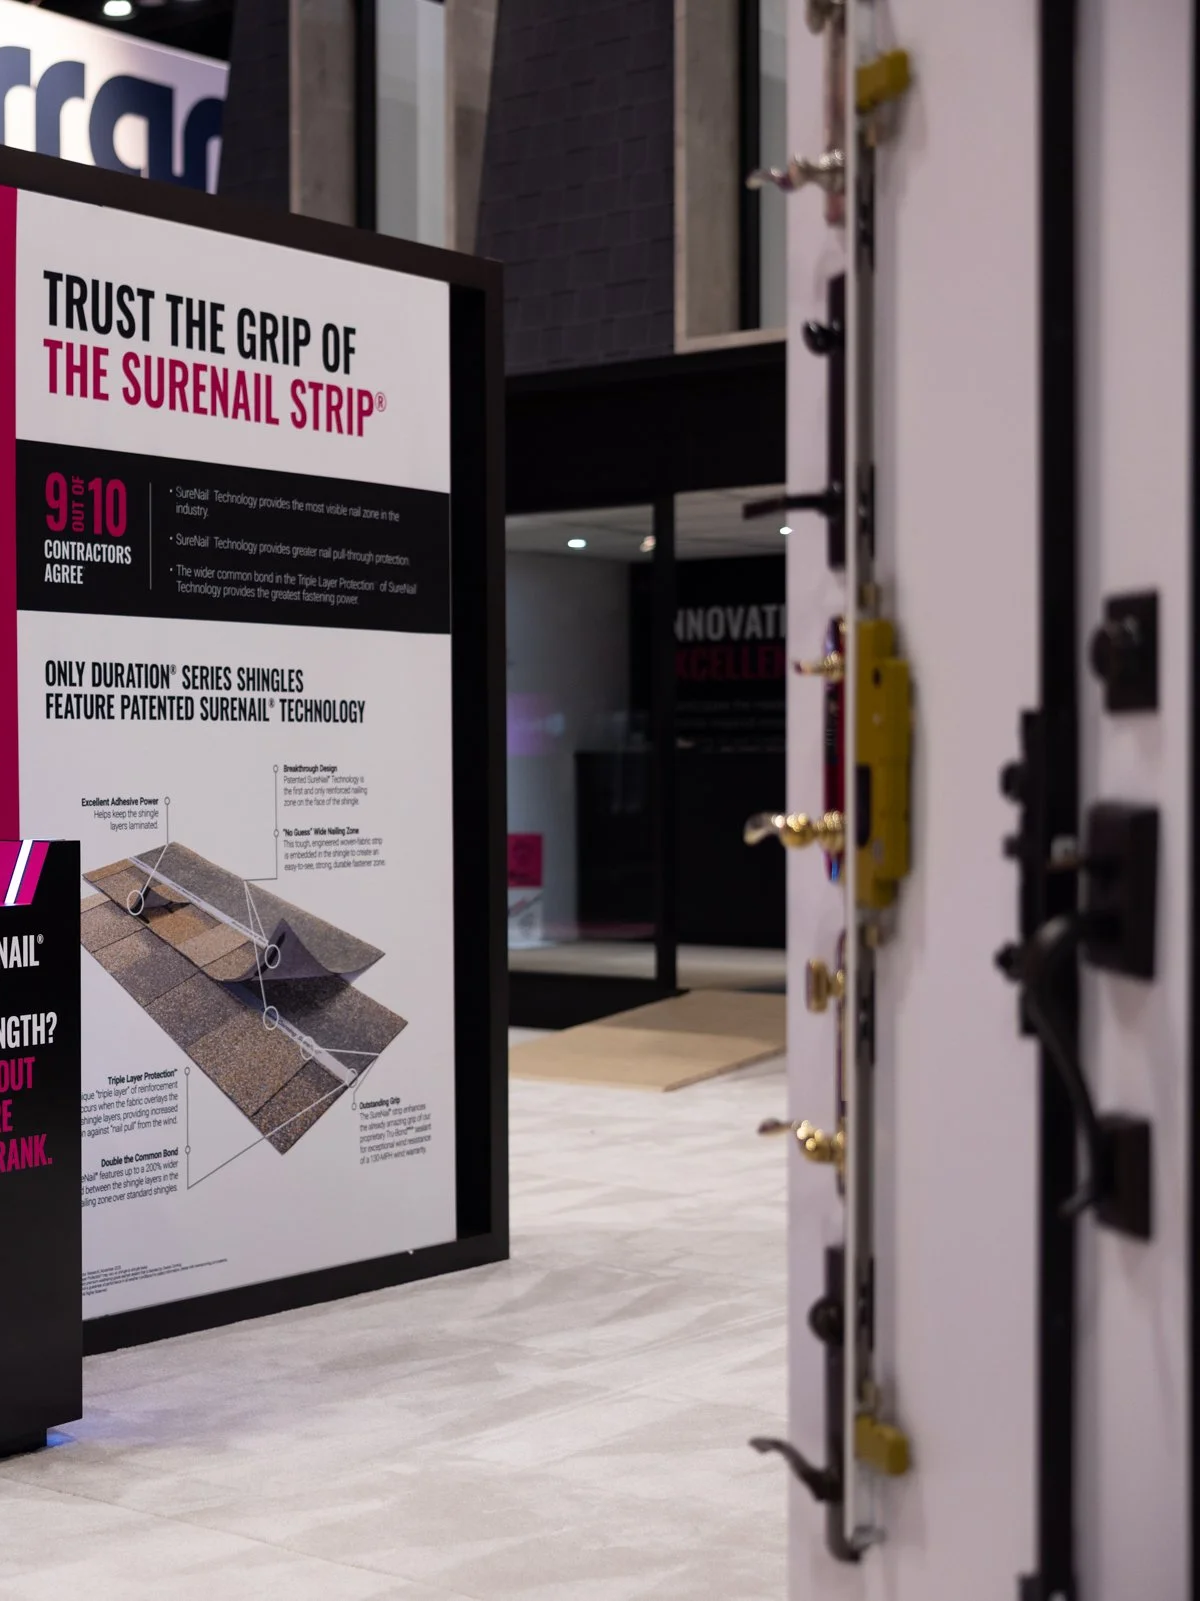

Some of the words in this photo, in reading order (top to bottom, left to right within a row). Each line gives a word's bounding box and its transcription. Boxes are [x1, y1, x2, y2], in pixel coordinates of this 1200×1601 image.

[43, 270, 154, 343] TRUST
[166, 295, 225, 355] THE
[237, 307, 310, 368] GRIP
[322, 323, 356, 375] OF
[43, 339, 109, 401] THE
[122, 351, 279, 426] SURENAIL
[72, 475, 85, 495] OF
[45, 471, 68, 532] 9
[88, 478, 127, 537] 10
[176, 503, 209, 519] industry.
[214, 490, 258, 509] Technology
[259, 498, 290, 509] provides
[292, 499, 304, 511] the
[305, 502, 325, 513] most
[326, 504, 348, 516] visible
[349, 507, 361, 517] nail
[362, 508, 379, 519] zone
[381, 510, 387, 520] in
[388, 511, 400, 522] the
[72, 497, 85, 532] OUT
[44, 540, 132, 565] CONTRACTORS
[214, 537, 258, 554] Technology
[259, 544, 291, 555] provides
[292, 545, 317, 558] greater
[319, 548, 332, 558] nail
[333, 550, 374, 564] pull-through
[44, 564, 84, 585] AGREE
[176, 564, 192, 577] The
[194, 566, 215, 578] wider
[217, 570, 252, 581] common
[254, 571, 274, 583] bond
[275, 574, 282, 584] in
[284, 574, 296, 585] the
[298, 574, 317, 588] Triple
[318, 576, 337, 590] Layer
[380, 581, 388, 592] of
[176, 581, 222, 598] Technology
[223, 586, 255, 598] provides
[257, 587, 269, 598] the
[271, 588, 300, 602] greatest
[302, 590, 335, 606] fastening
[673, 603, 786, 641] NNOVATI
[45, 660, 86, 688] ONLY
[182, 666, 232, 691] SERIES
[237, 668, 304, 693] SHINGLES
[45, 694, 115, 720] FEATURE
[121, 695, 194, 721] PATENTED
[280, 699, 365, 724] TECHNOLOGY
[284, 765, 318, 774] Breakthrough
[320, 765, 337, 773] Design
[81, 796, 109, 807] Excellent
[111, 796, 138, 807] Adhesive
[140, 796, 159, 807] Power
[93, 809, 111, 820] Helps
[112, 810, 126, 820] keep
[127, 809, 137, 818] the
[138, 809, 159, 820] shingle
[110, 820, 127, 832] layers
[328, 828, 345, 836] Nailing
[346, 827, 359, 835] Zone
[108, 1074, 126, 1086] Triple
[126, 1073, 143, 1085] Layer
[131, 1086, 137, 1095] of
[138, 1080, 178, 1093] reinforcement
[98, 1101, 115, 1112] when
[116, 1099, 126, 1109] the
[126, 1097, 143, 1108] fabric
[144, 1094, 168, 1106] overlays
[169, 1093, 178, 1102] the
[123, 1107, 150, 1120] providing
[151, 1105, 178, 1116] increased
[359, 1098, 389, 1110] Outstanding
[390, 1097, 400, 1105] Grip
[87, 1124, 109, 1138] against
[138, 1120, 152, 1131] from
[153, 1118, 162, 1128] the
[101, 1156, 123, 1168] Double
[124, 1156, 134, 1164] the
[135, 1150, 162, 1164] Common
[163, 1148, 178, 1158] Bond
[99, 1166, 124, 1181] features
[125, 1166, 133, 1176] up
[133, 1165, 140, 1175] to
[141, 1166, 145, 1174] a
[146, 1161, 162, 1173] 200%
[163, 1160, 178, 1171] wider
[85, 1182, 111, 1195] between
[112, 1180, 122, 1190] the
[123, 1177, 144, 1190] shingle
[145, 1175, 162, 1188] layers
[163, 1173, 169, 1181] in
[169, 1171, 178, 1181] the
